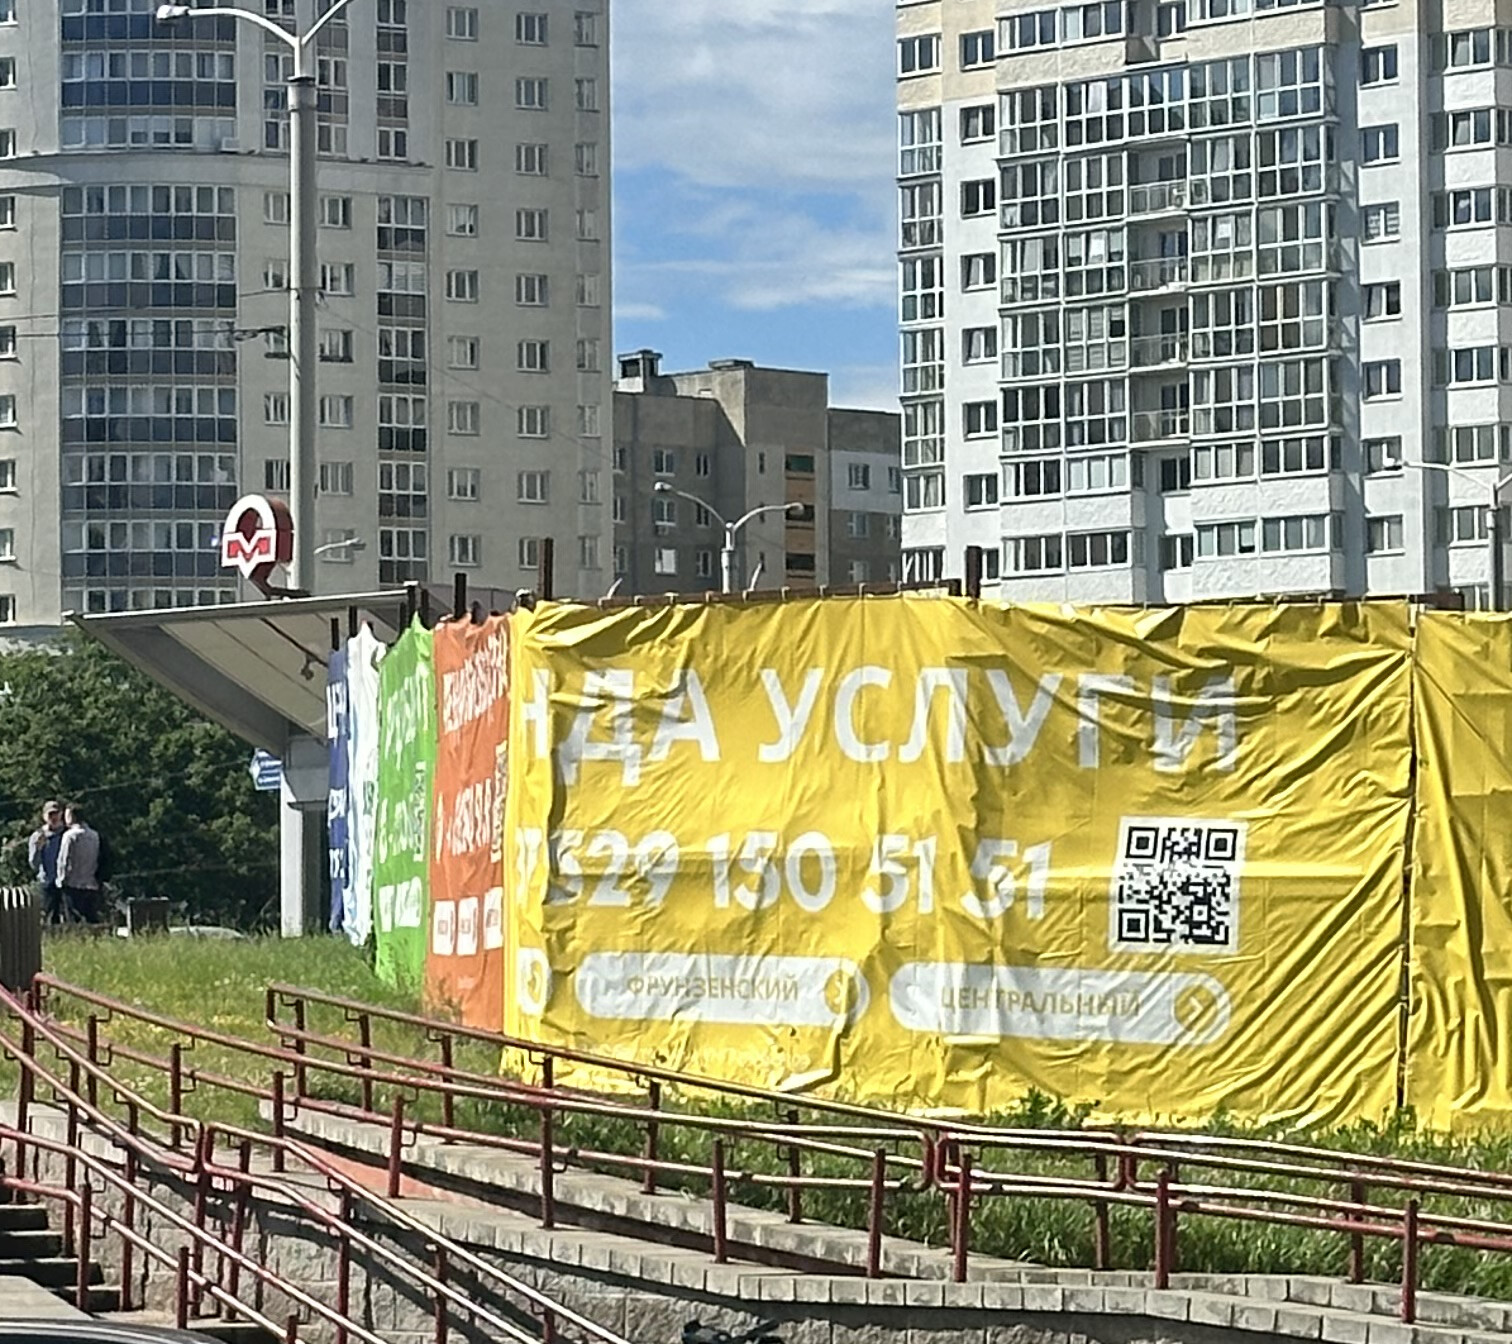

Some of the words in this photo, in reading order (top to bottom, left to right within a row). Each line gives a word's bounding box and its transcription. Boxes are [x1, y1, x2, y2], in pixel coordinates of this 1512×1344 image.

[757, 665, 1236, 772] УСЛУГИ
[705, 829, 837, 912] 150
[860, 834, 937, 914] 51
[959, 838, 1052, 920] 51
[626, 971, 799, 1002] ФРУНЗЕНСКИЙ
[940, 985, 1140, 1017] ЦЕНТРАЛЬНЫЙ
